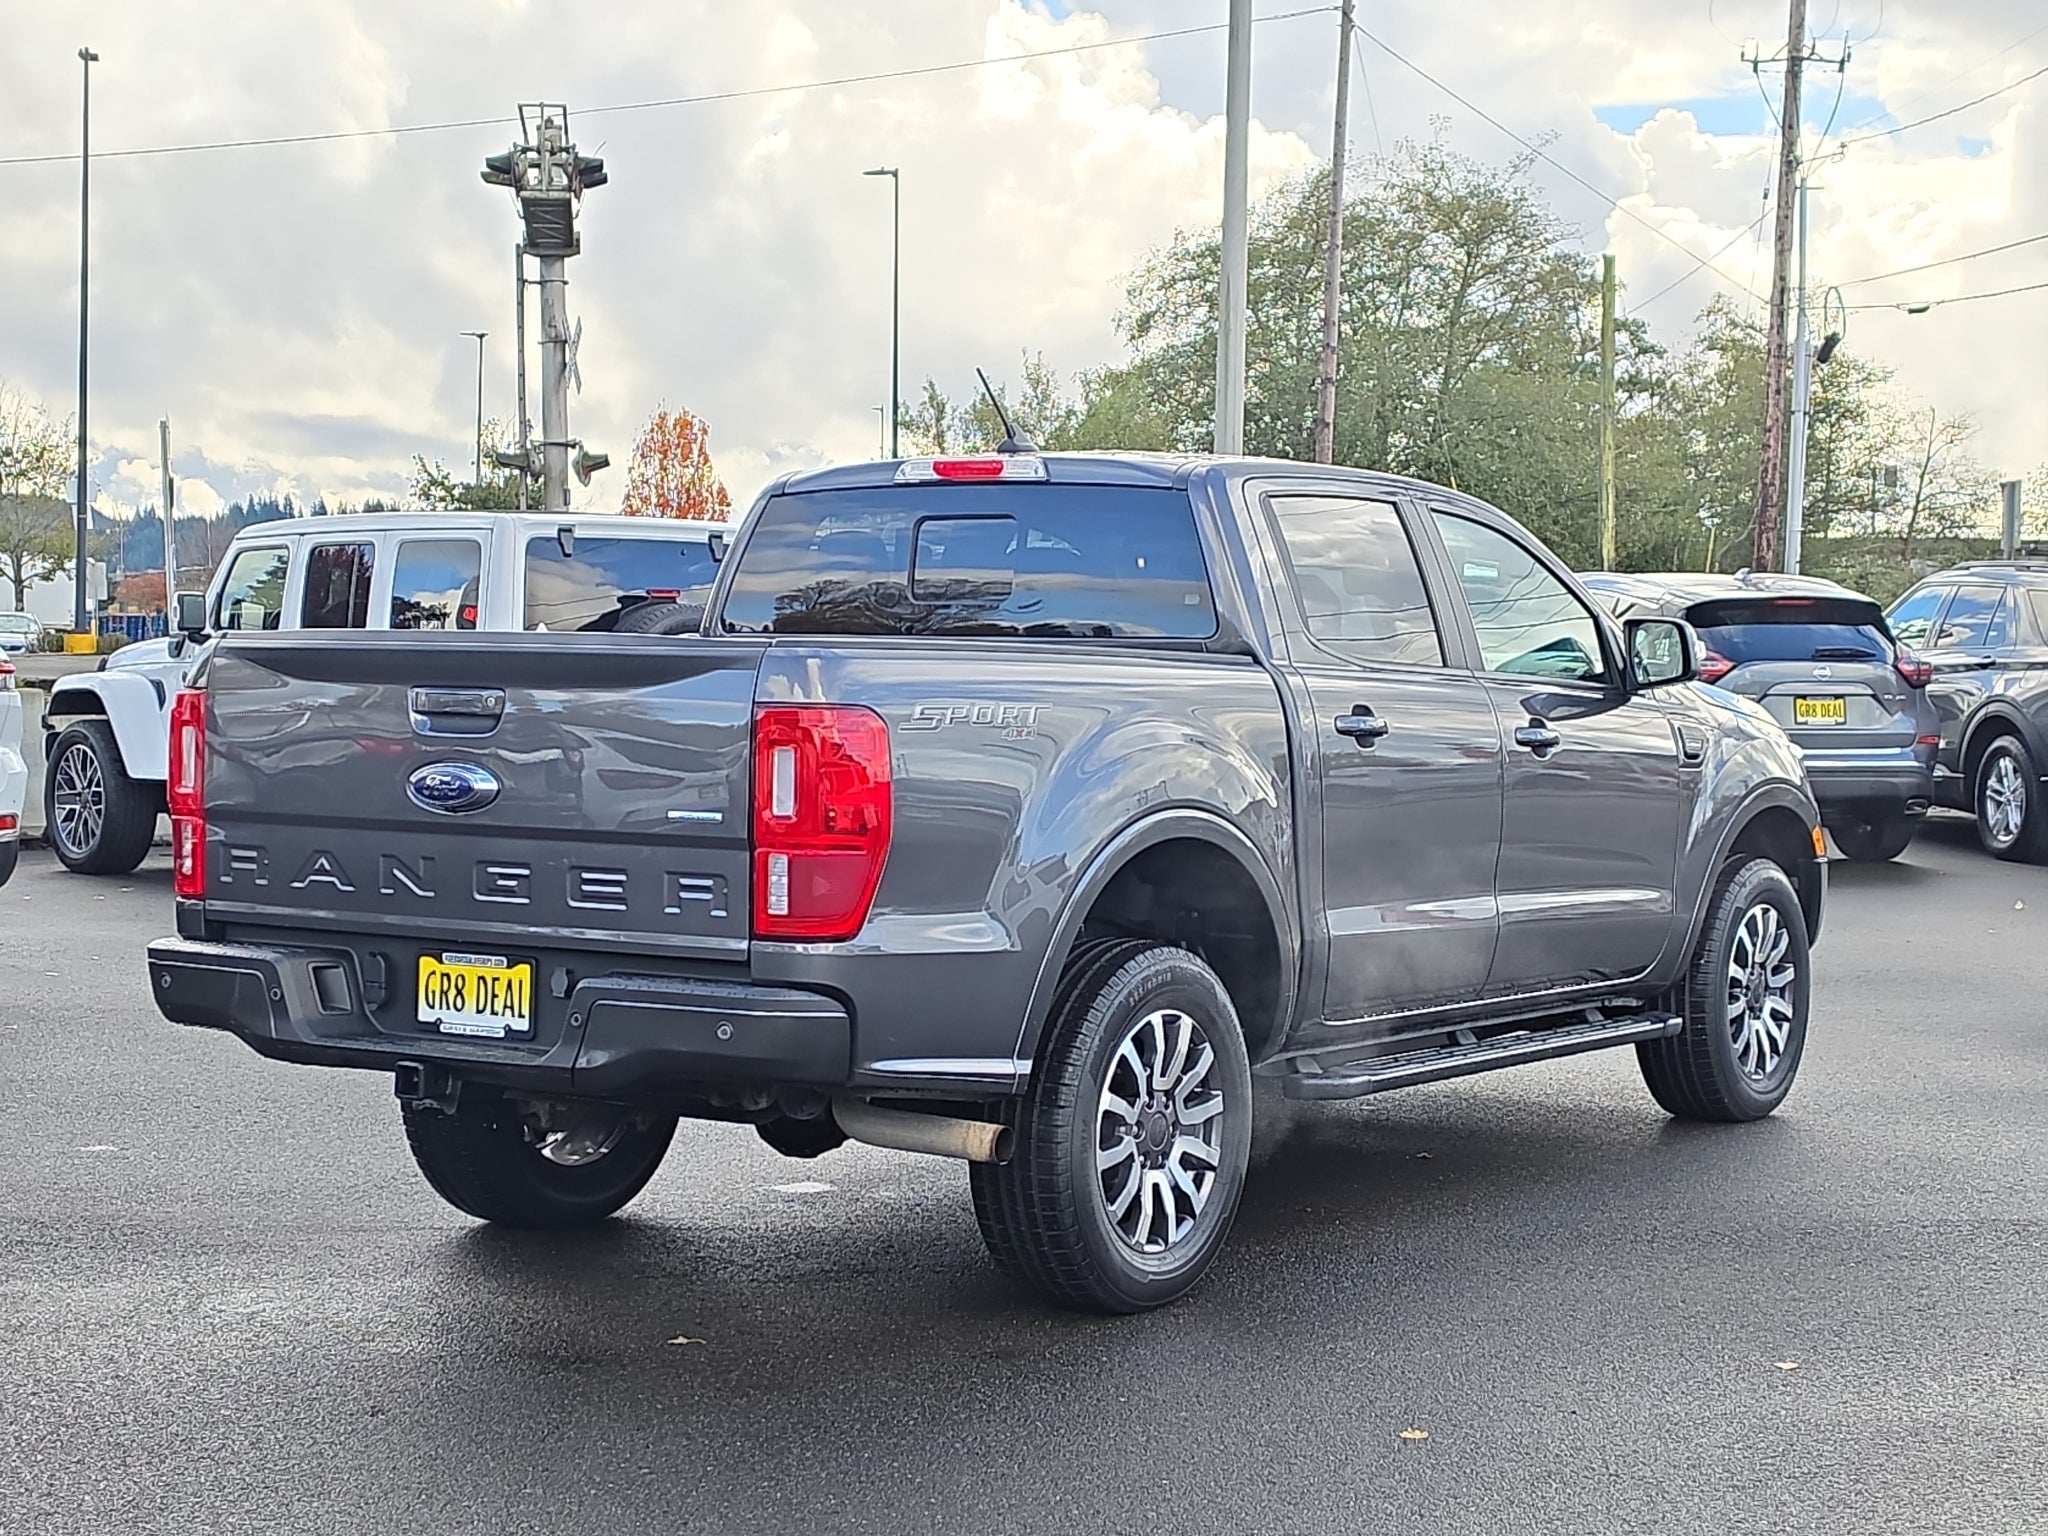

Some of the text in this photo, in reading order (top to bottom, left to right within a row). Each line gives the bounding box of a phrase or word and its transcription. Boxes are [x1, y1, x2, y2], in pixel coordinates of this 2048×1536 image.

[897, 702, 1053, 733] SPORT
[1798, 702, 1844, 718] GR8 DEAL
[219, 842, 729, 918] RANGER
[424, 969, 527, 1020] GR8 DEAL
